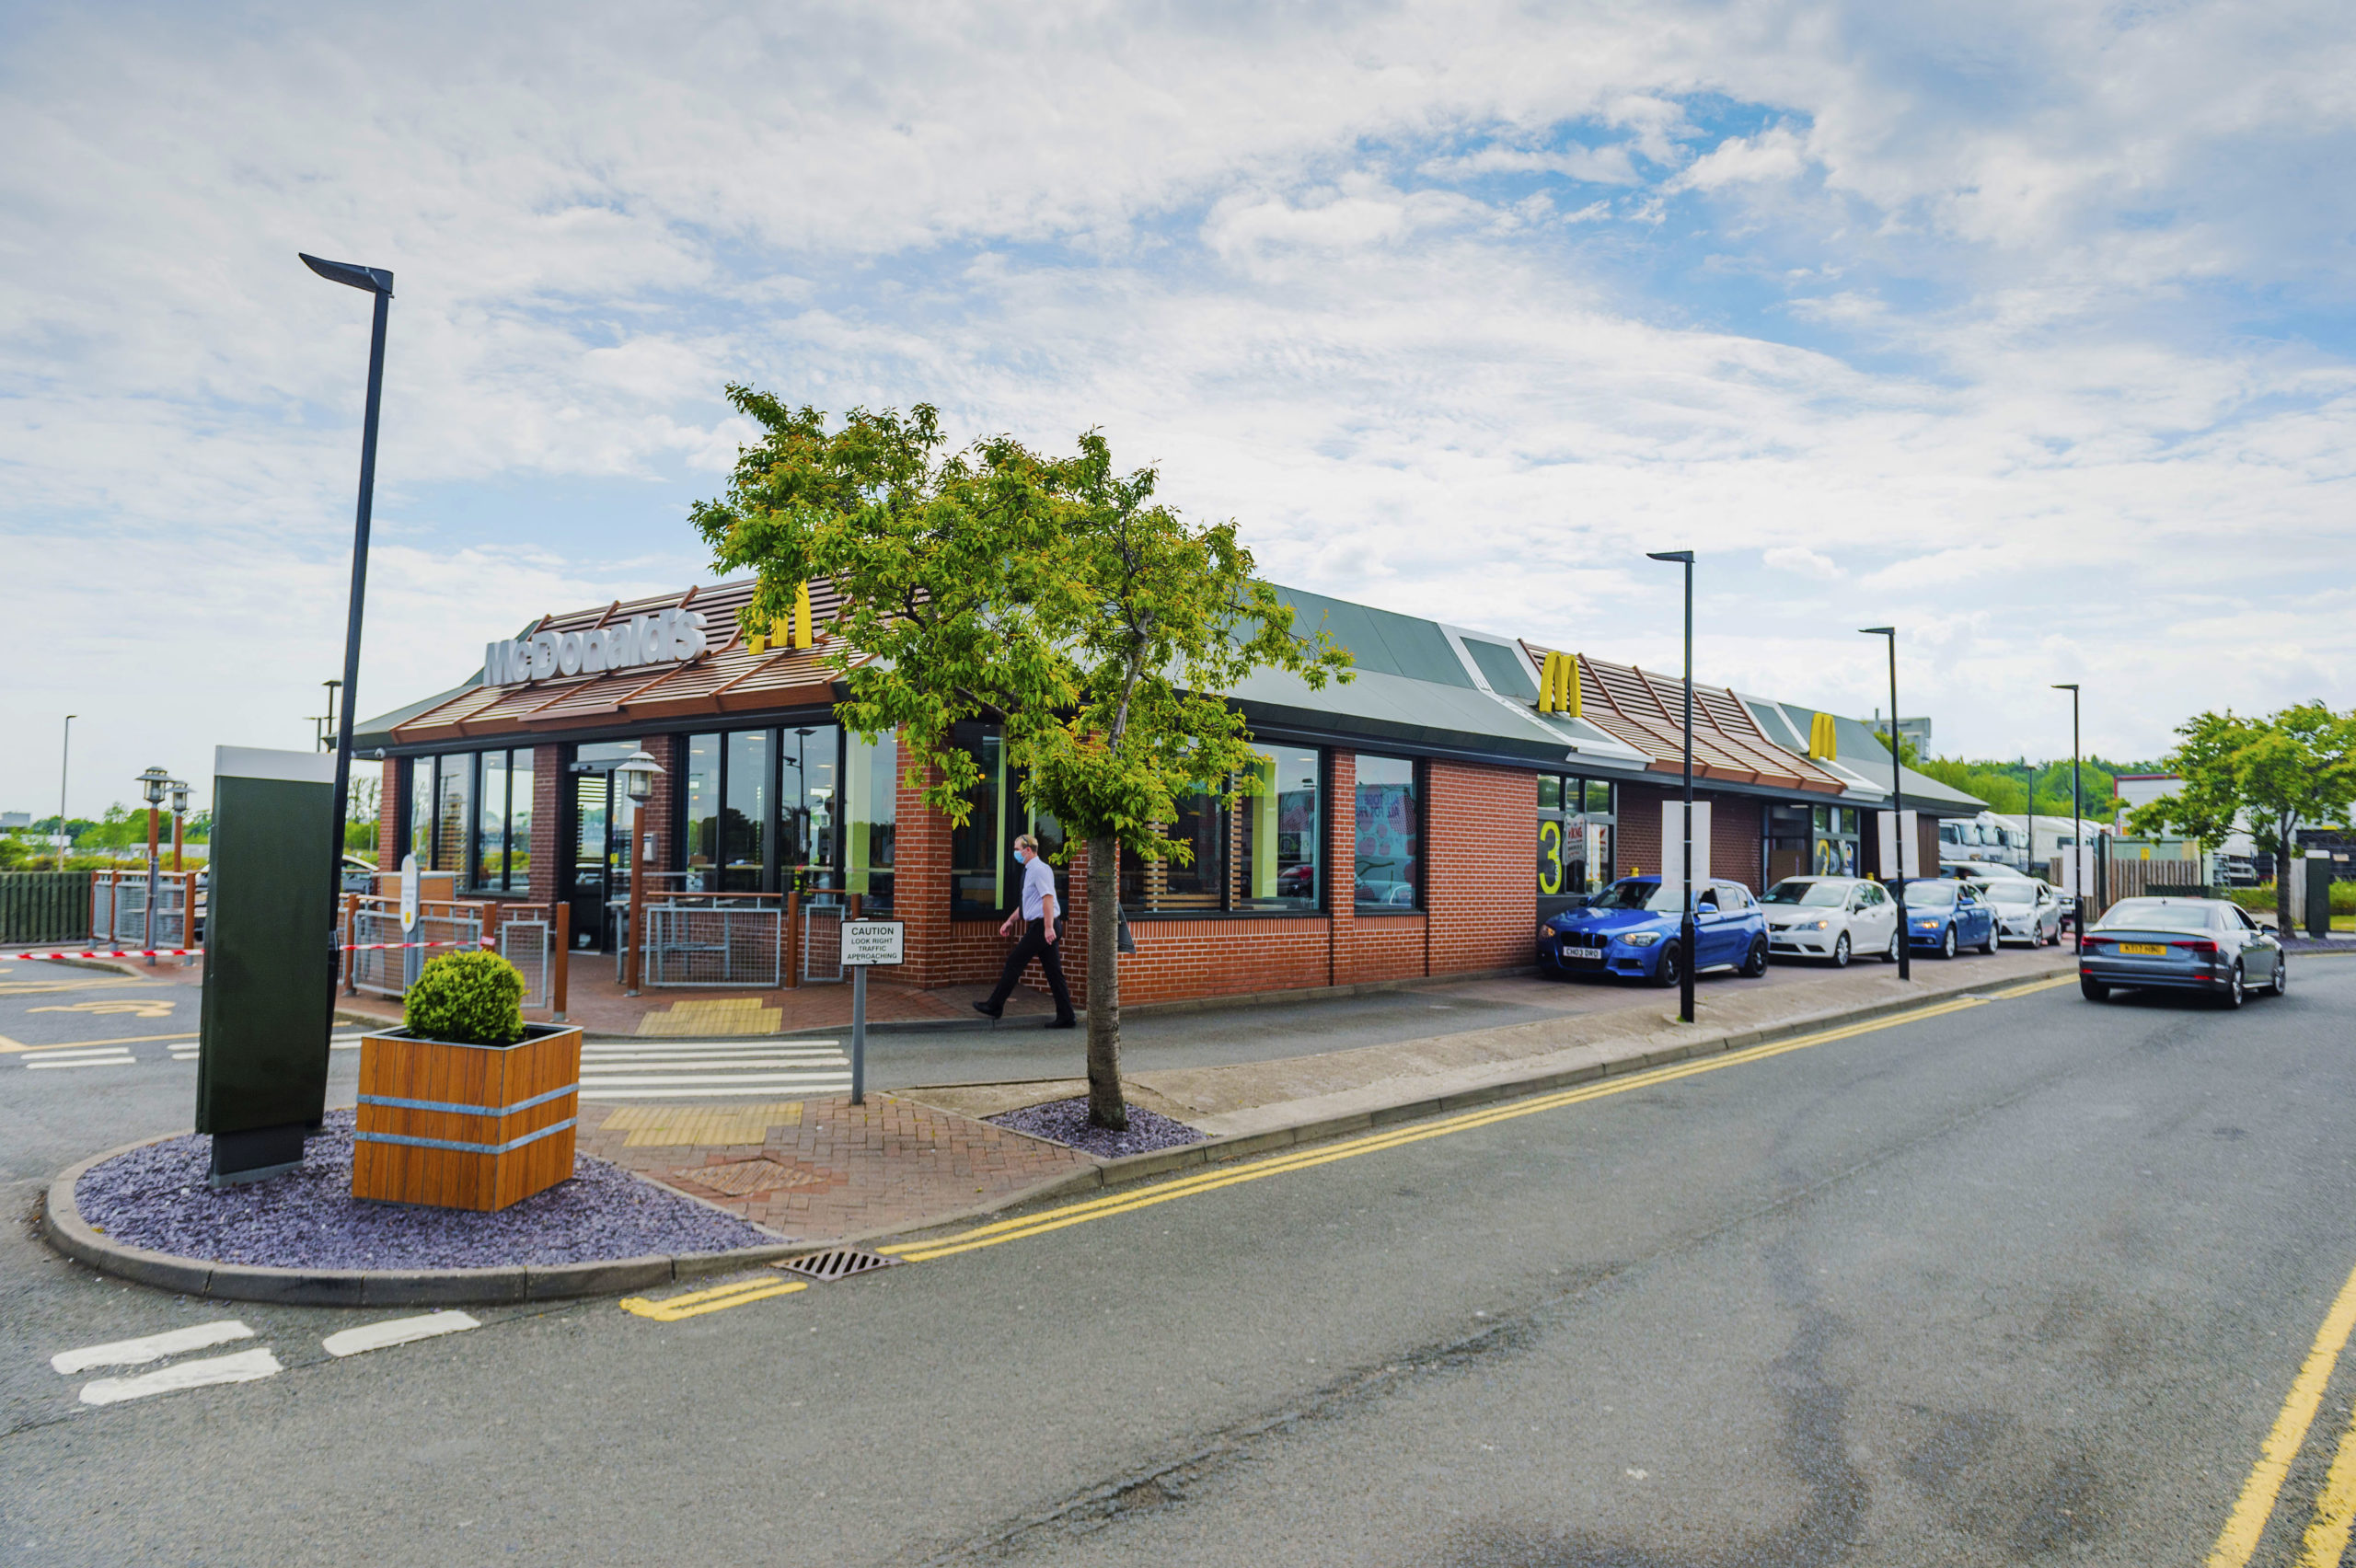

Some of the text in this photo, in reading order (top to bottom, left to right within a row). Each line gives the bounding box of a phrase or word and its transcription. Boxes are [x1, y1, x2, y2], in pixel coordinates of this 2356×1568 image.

[483, 608, 708, 687] McDonald's
[1539, 821, 1563, 894] 3
[851, 927, 894, 936] CAUTION
